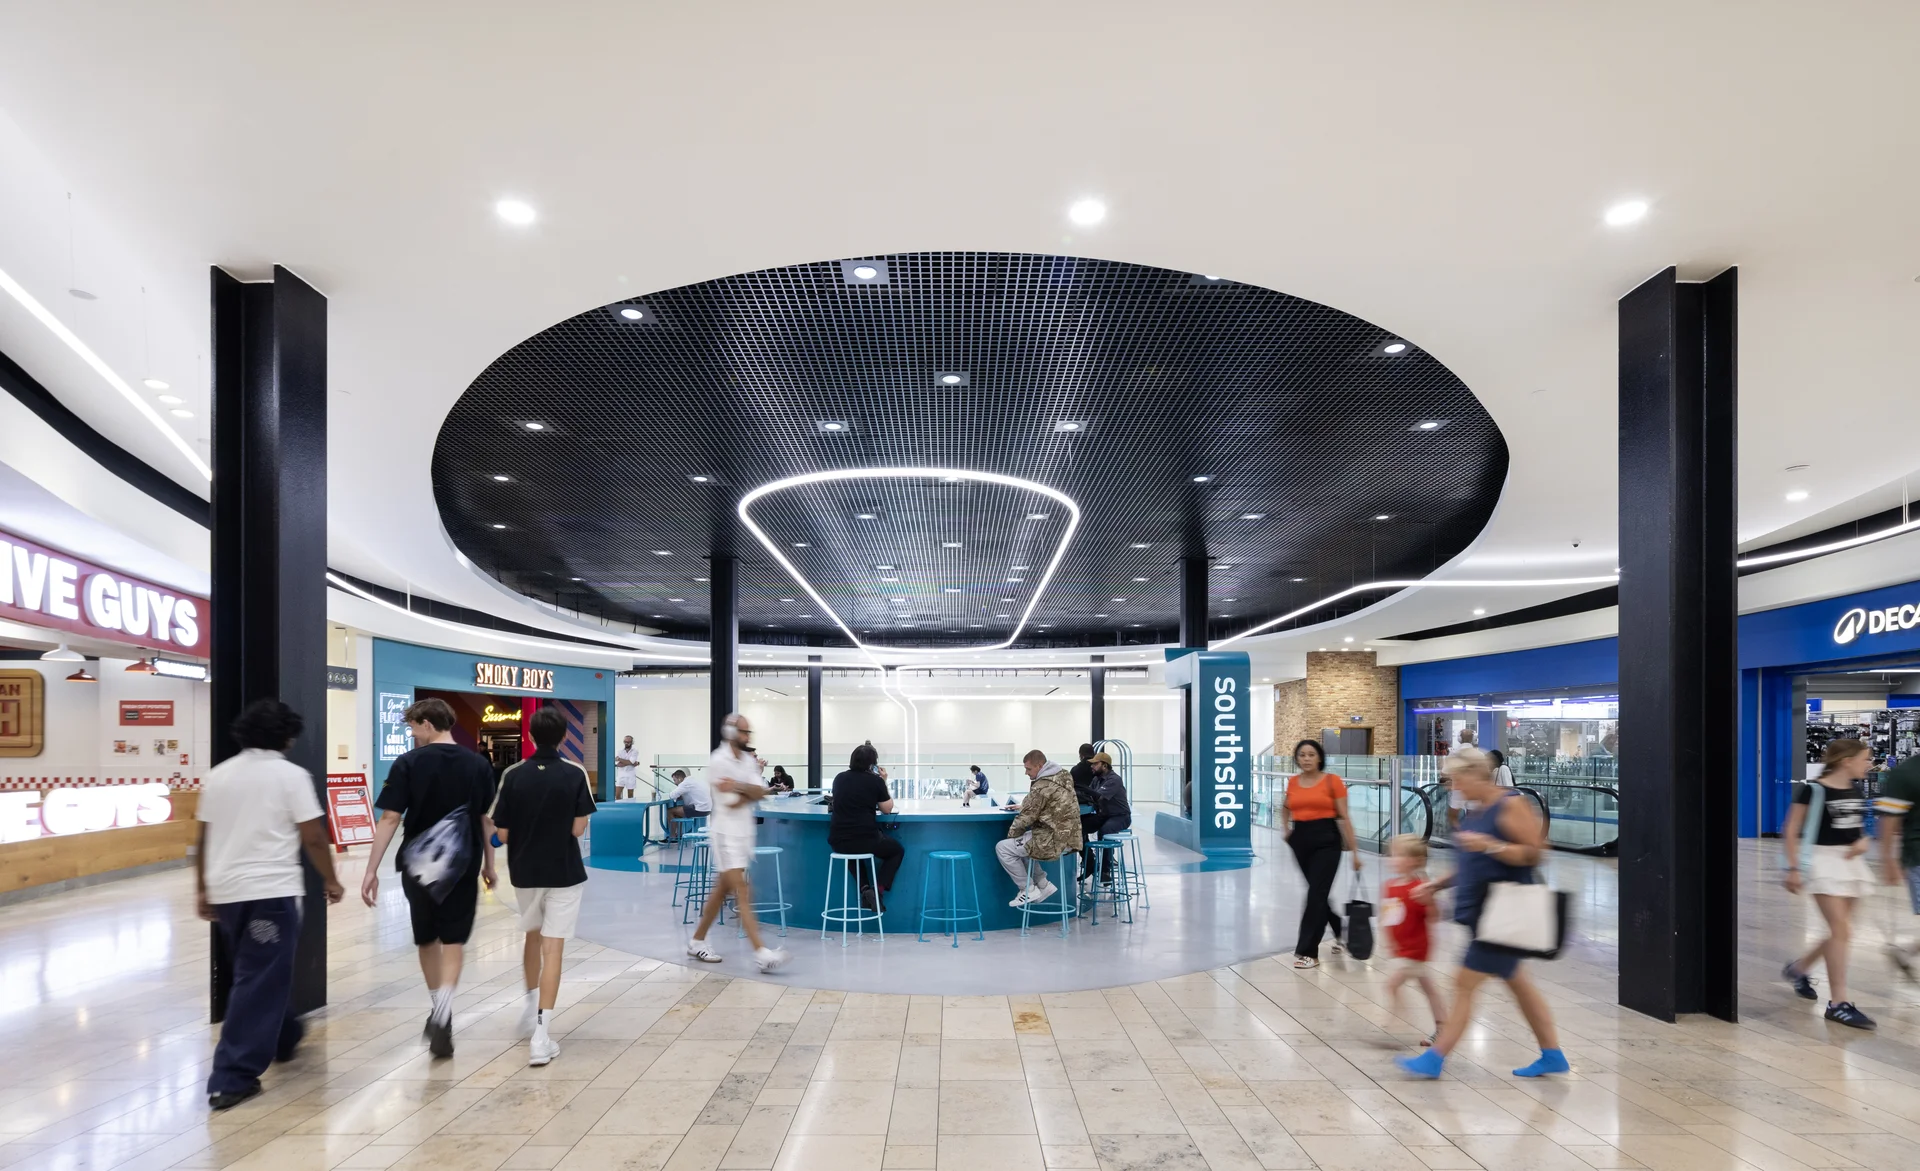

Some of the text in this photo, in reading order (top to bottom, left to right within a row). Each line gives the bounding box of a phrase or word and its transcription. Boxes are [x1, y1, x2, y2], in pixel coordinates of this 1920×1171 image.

[86, 573, 199, 647] GUYS
[476, 663, 554, 689] SMOKY BOYS
[1214, 676, 1243, 829] southside
